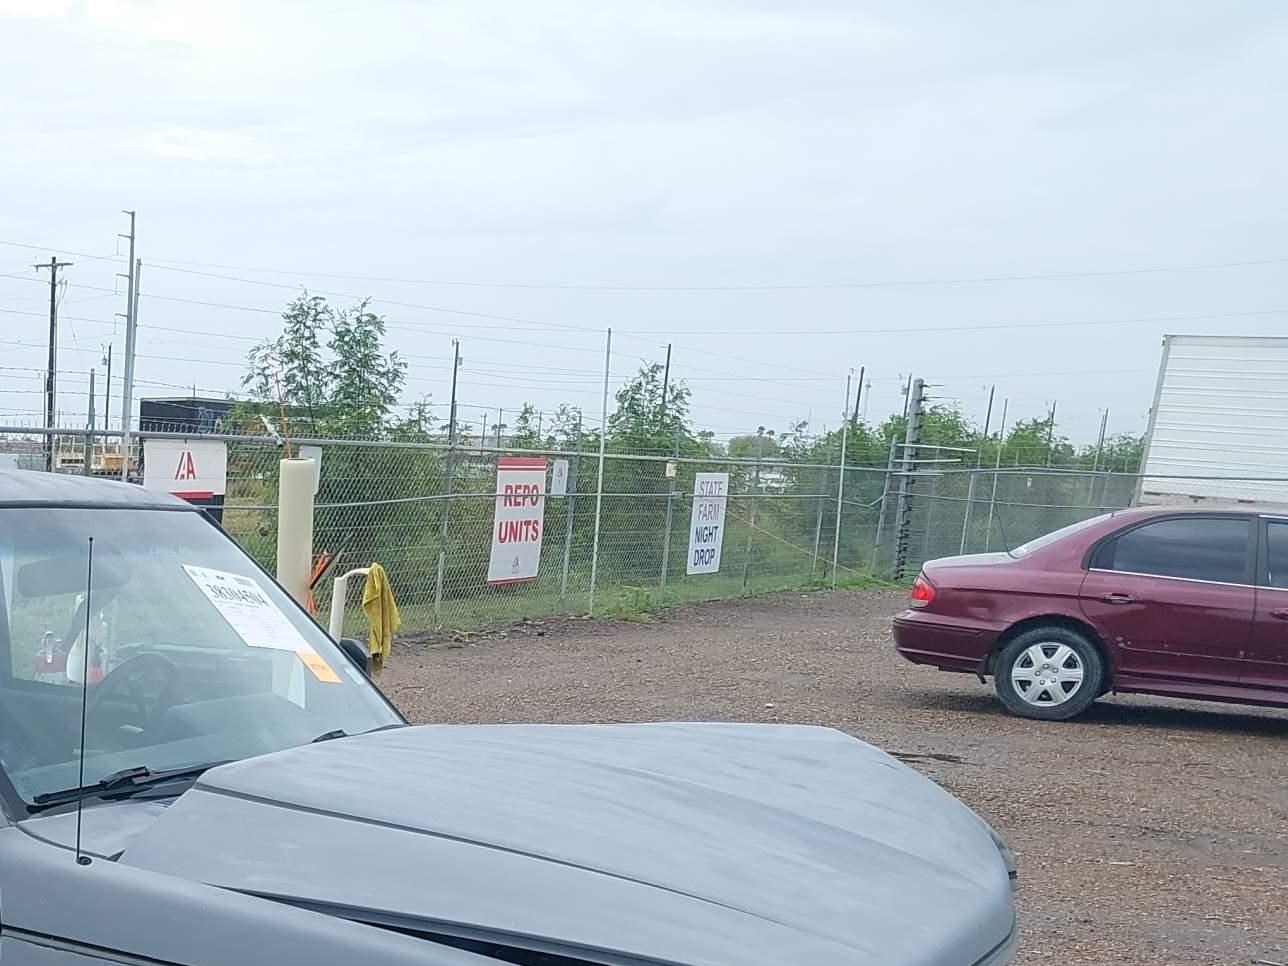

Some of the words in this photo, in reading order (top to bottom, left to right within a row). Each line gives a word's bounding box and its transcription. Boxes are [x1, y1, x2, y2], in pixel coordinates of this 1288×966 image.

[503, 484, 539, 507] REPO
[699, 480, 724, 497] STATE
[697, 503, 720, 521] FARM
[498, 520, 539, 543] UNITS
[694, 525, 720, 544] NIGHT
[693, 548, 716, 567] DROP
